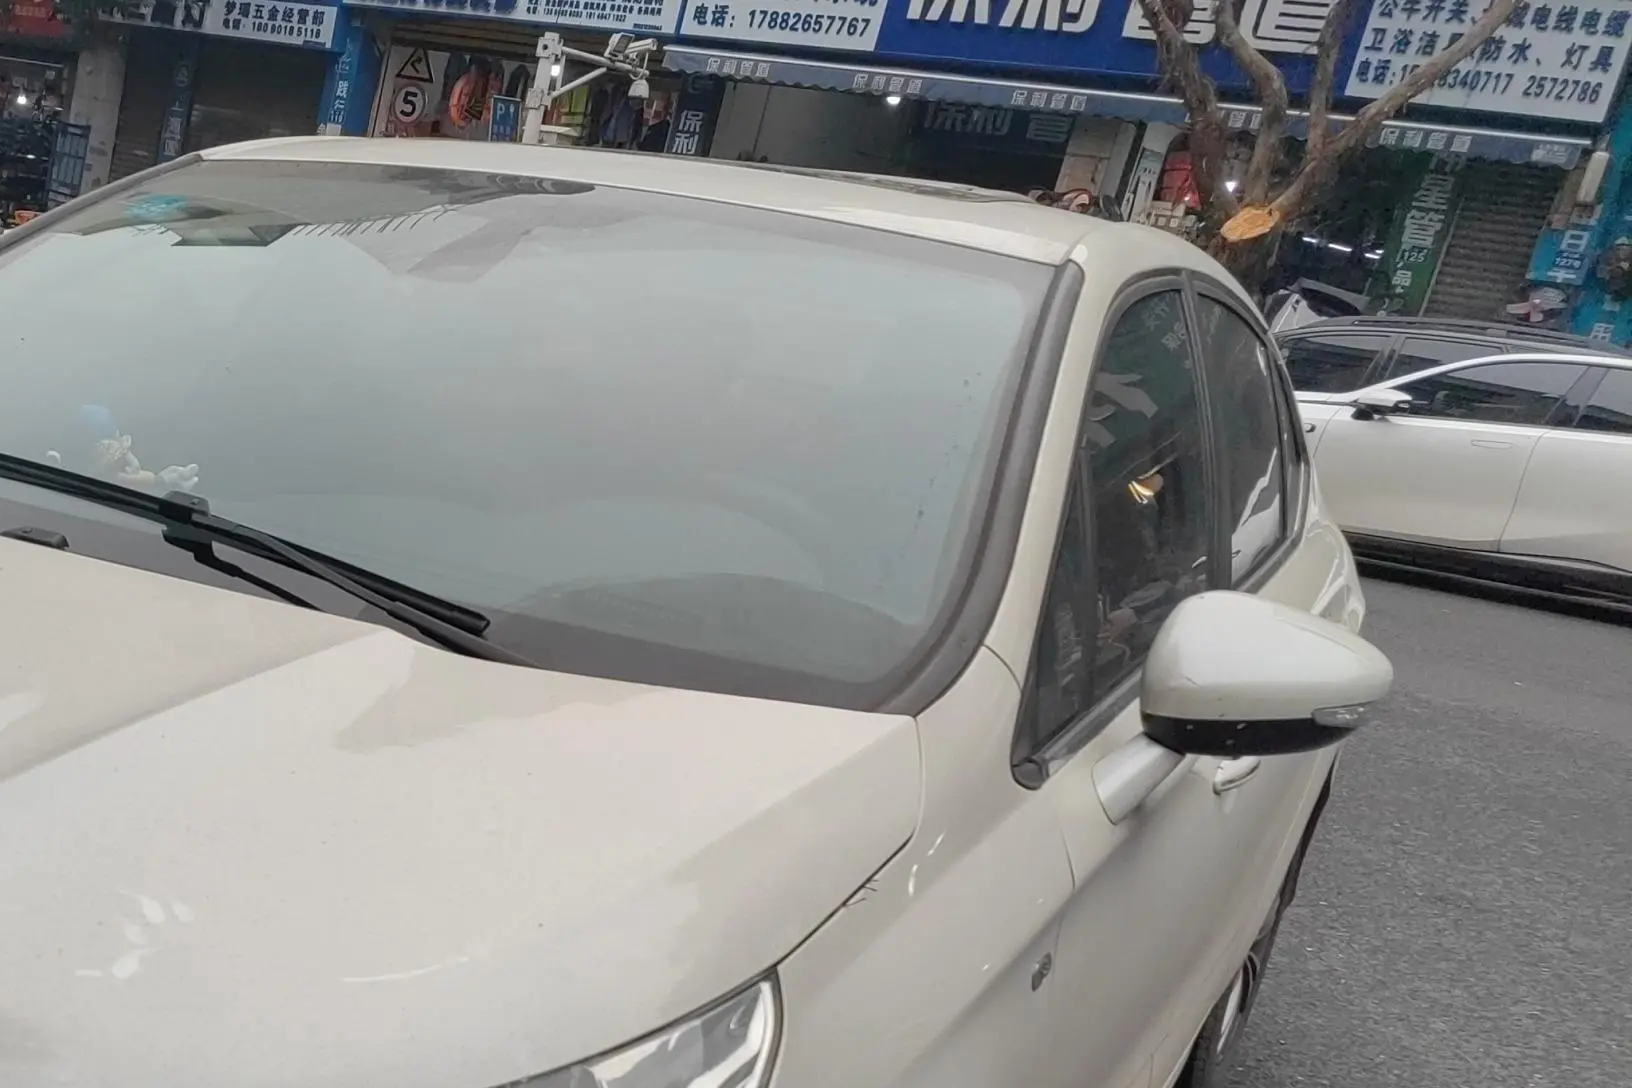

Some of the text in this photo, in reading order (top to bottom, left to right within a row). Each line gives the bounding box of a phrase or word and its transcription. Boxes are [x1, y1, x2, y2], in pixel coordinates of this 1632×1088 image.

[748, 9, 871, 37] 17882657767
[1522, 74, 1604, 104] 2572786
[400, 90, 418, 118] 5
